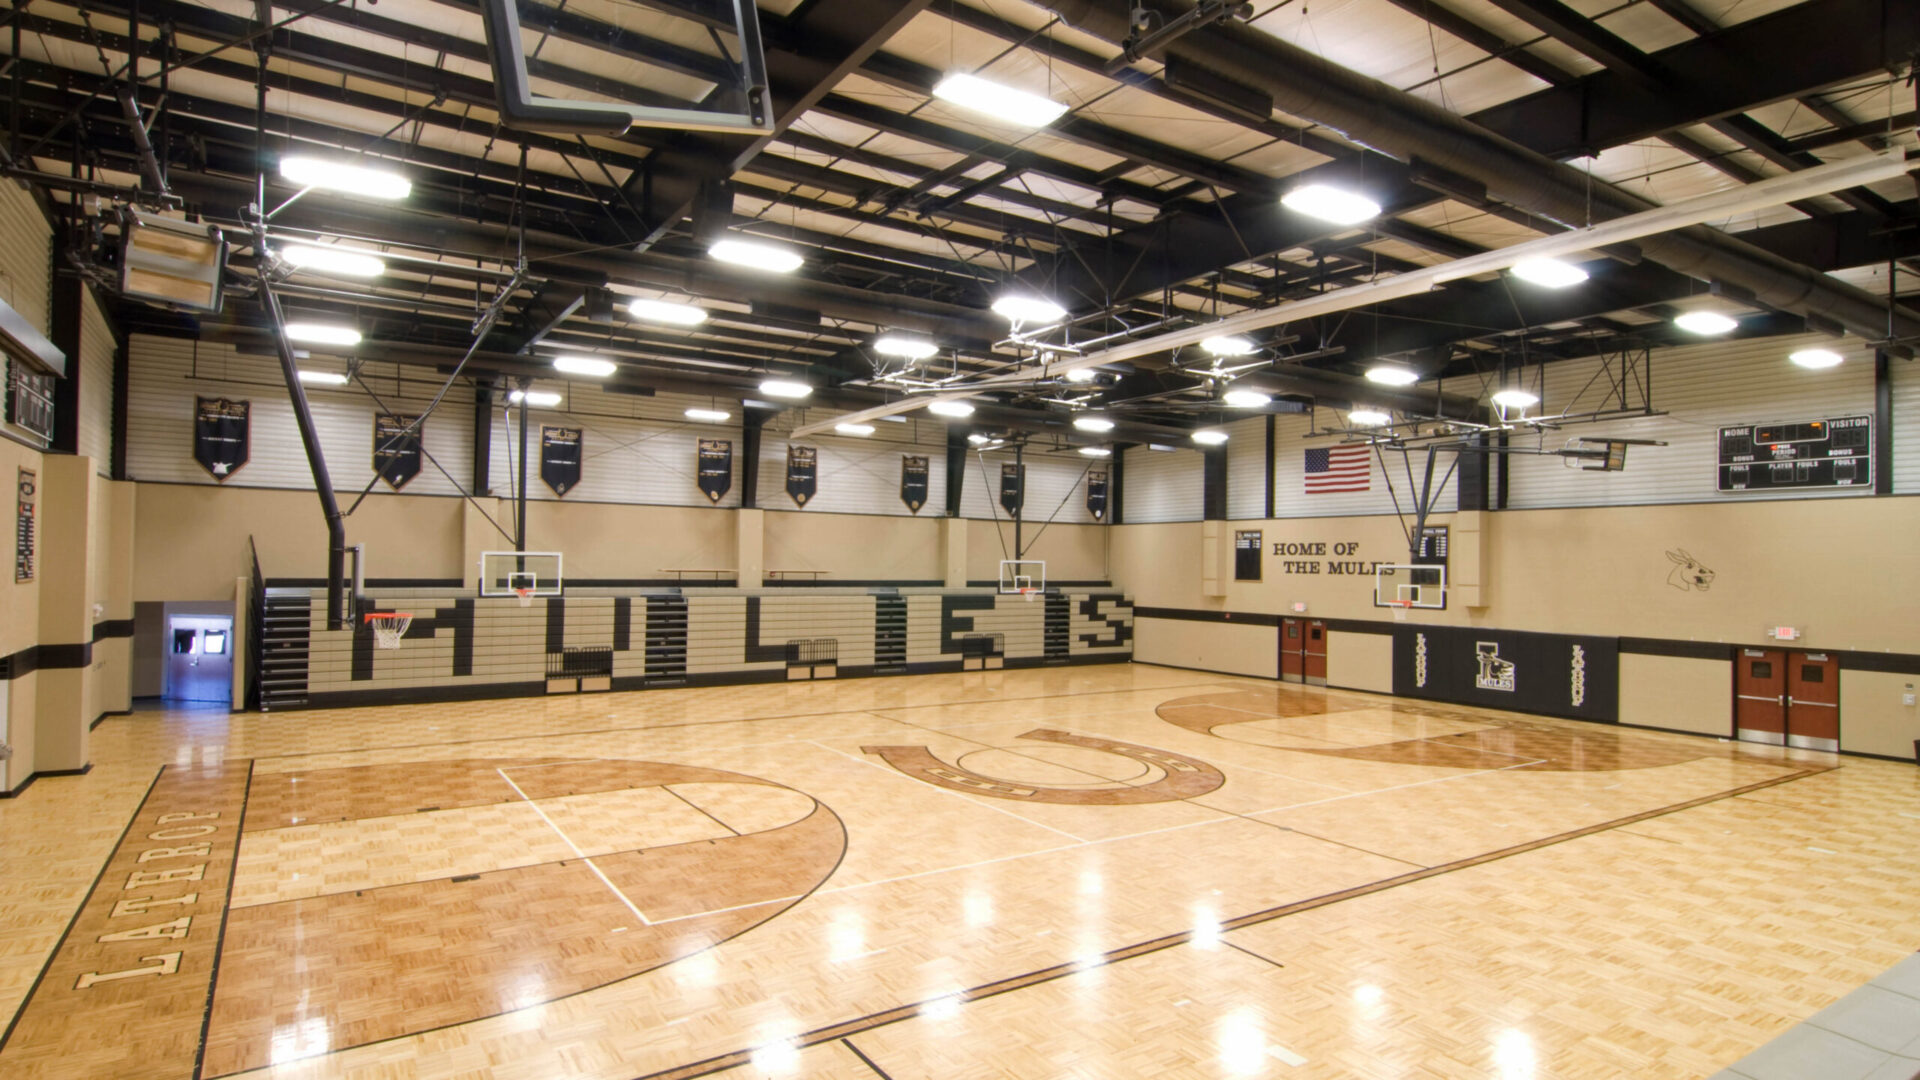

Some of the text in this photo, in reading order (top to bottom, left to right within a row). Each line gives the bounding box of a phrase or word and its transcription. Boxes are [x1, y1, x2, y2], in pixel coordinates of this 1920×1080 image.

[1830, 418, 1869, 428] VISITOR
[1725, 428, 1750, 437] HOME
[1772, 448, 1796, 456] PERIOD
[1828, 448, 1853, 456] BONUS
[1797, 460, 1818, 468] FOULS
[1834, 458, 1856, 466] FOULS
[1273, 542, 1359, 556] HOME OF
[1284, 561, 1320, 574] THE
[1480, 679, 1512, 689] MULES
[72, 811, 221, 990] LATHROP
